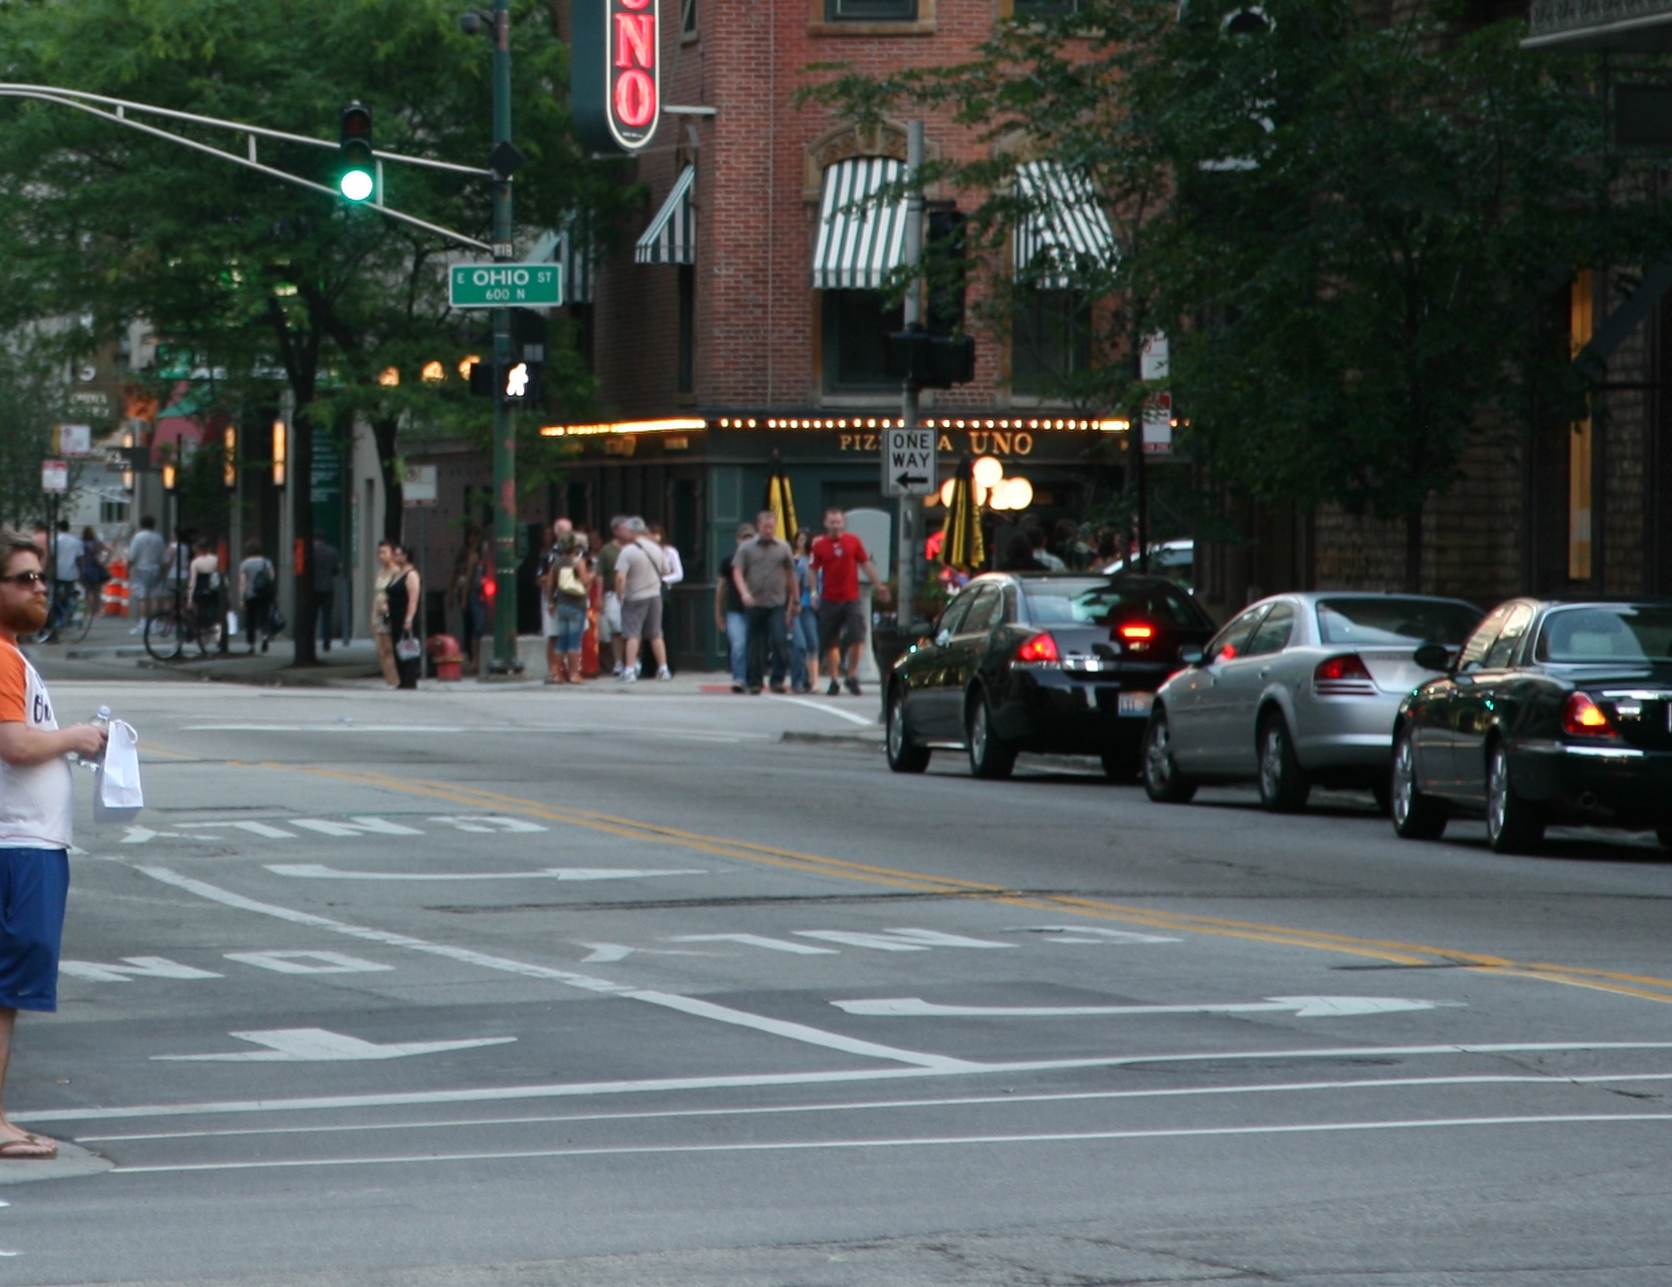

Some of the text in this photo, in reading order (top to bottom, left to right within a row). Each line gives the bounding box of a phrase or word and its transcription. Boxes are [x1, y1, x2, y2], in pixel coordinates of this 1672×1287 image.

[457, 269, 552, 287] E OHIO ST
[485, 288, 526, 300] 600 N
[893, 433, 930, 450] ONE
[969, 430, 1034, 456] UNO
[892, 452, 931, 469] WAY
